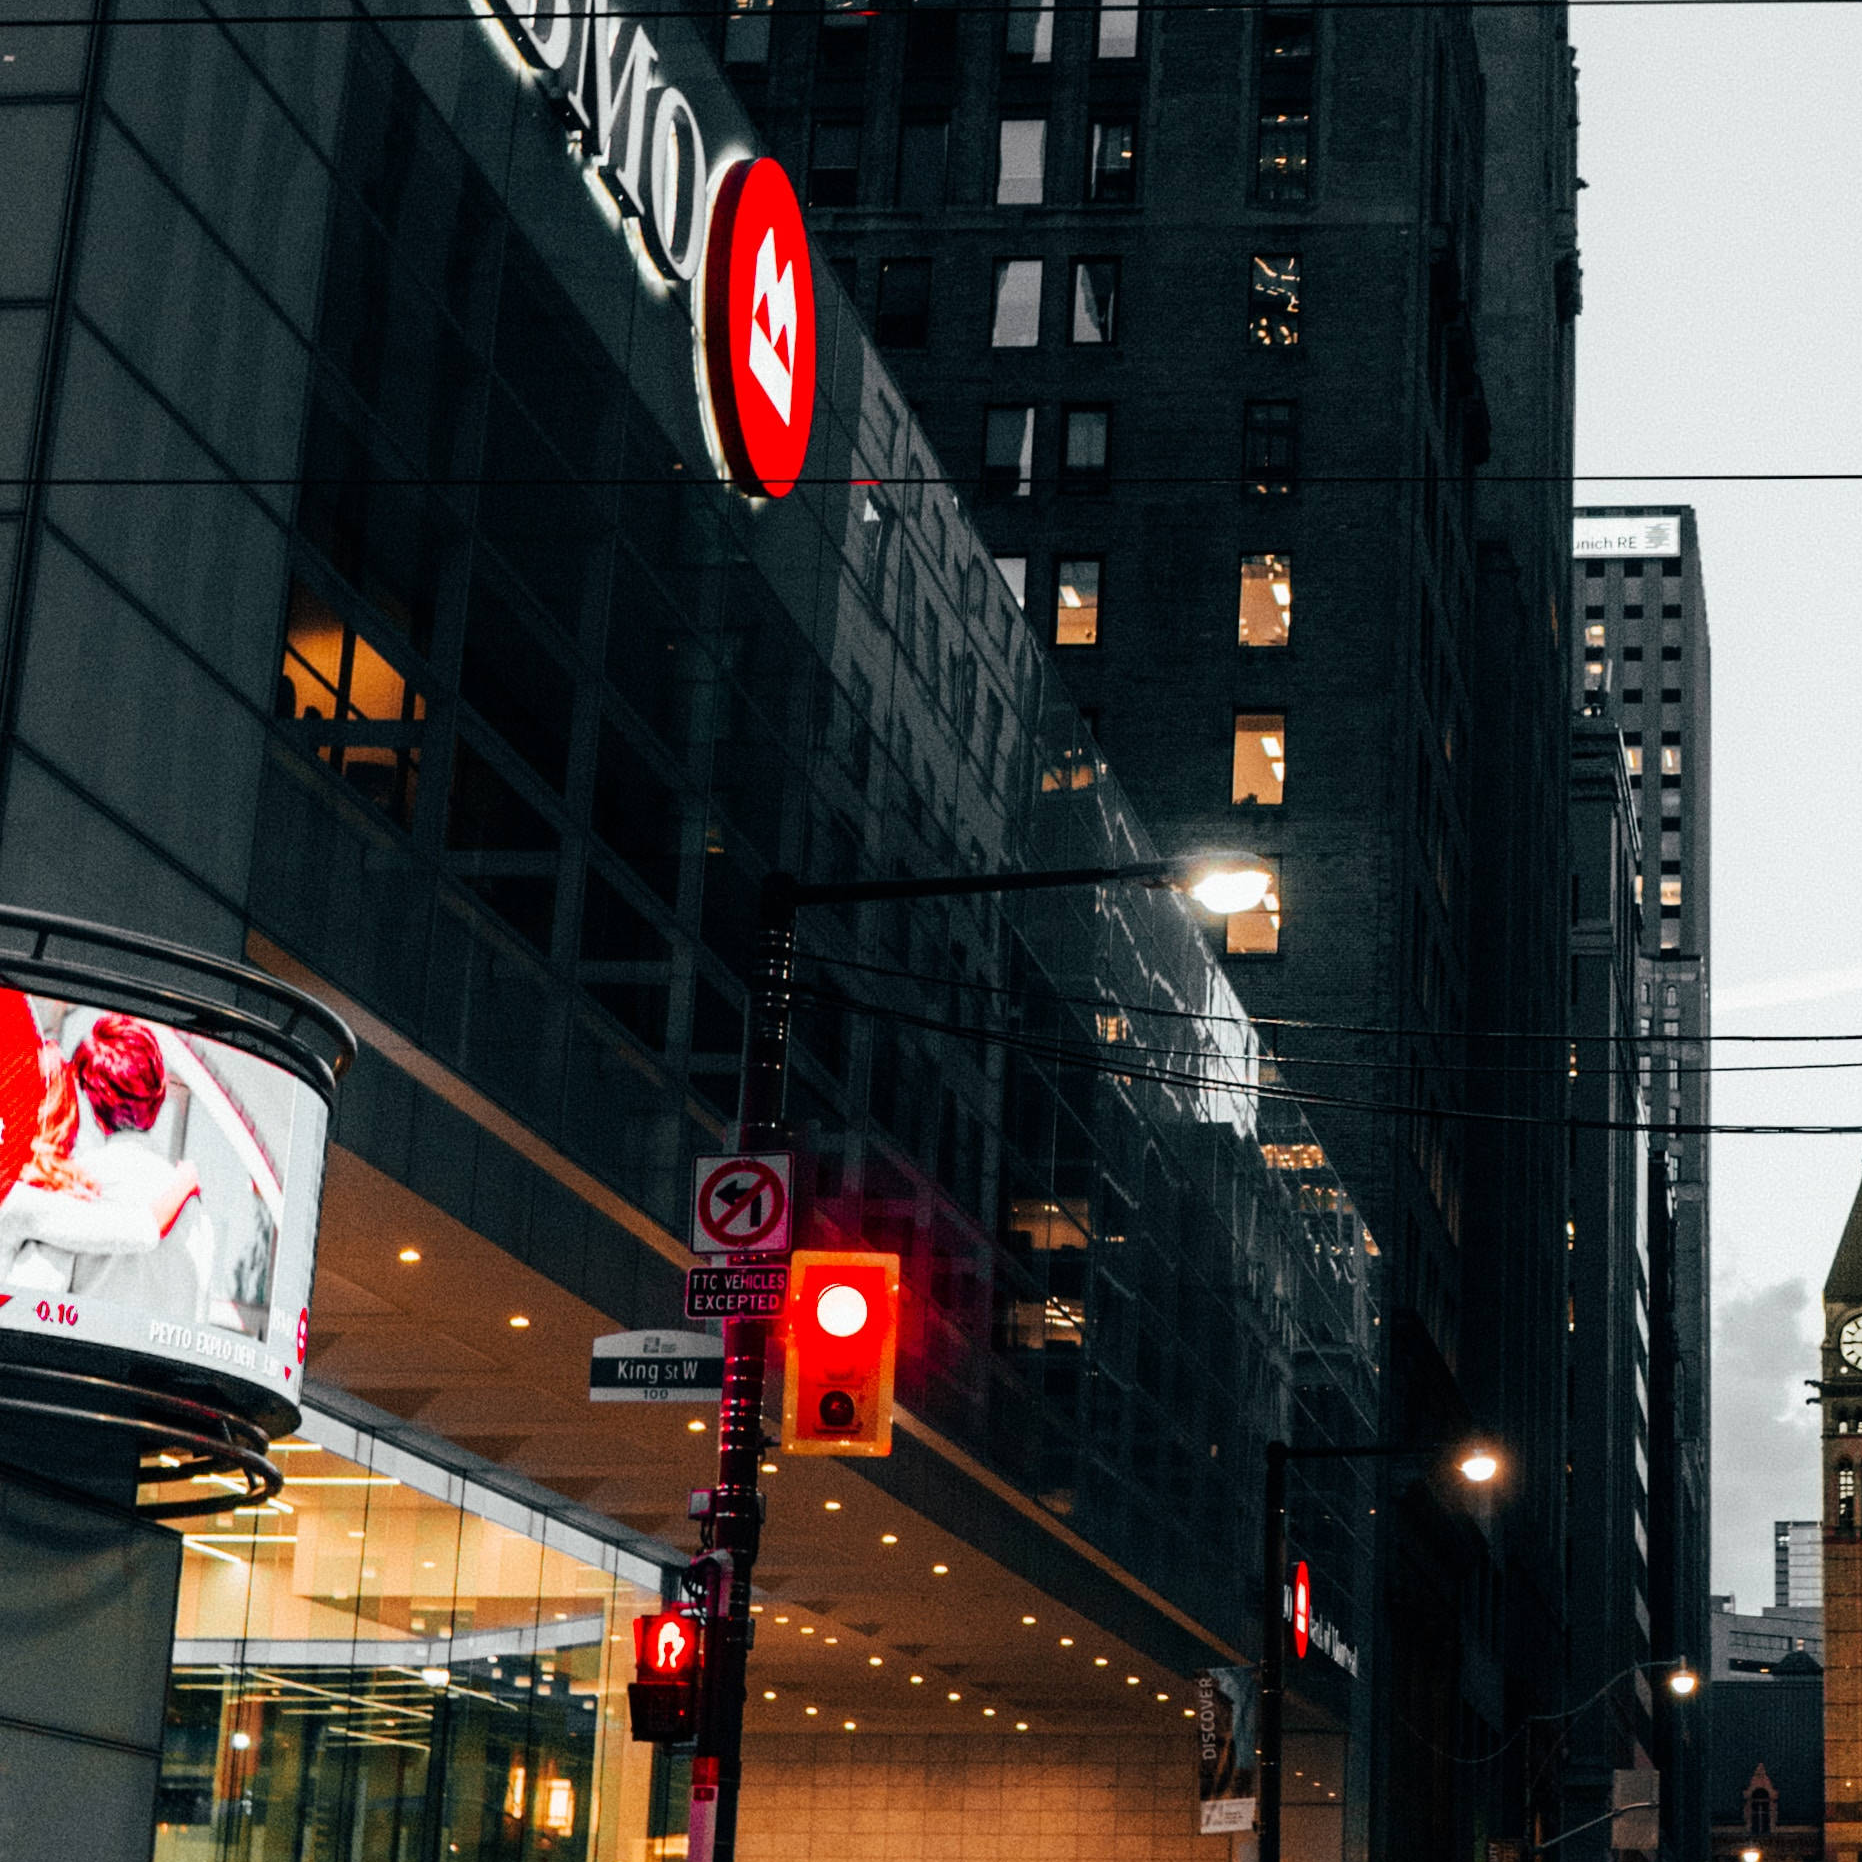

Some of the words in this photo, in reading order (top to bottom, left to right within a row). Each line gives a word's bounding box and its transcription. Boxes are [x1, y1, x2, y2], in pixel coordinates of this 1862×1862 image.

[1575, 536, 1613, 550] unich
[1617, 536, 1637, 549] RE
[690, 1273, 719, 1289] TTC
[722, 1272, 786, 1290] VEHICLES
[693, 1294, 780, 1311] EXCEPTED
[149, 1319, 192, 1350] PEYTO
[617, 1359, 660, 1384] King
[664, 1363, 679, 1380] St
[682, 1360, 699, 1380] W
[643, 1389, 669, 1400] 100
[1199, 1676, 1218, 1761] DISCOVER
